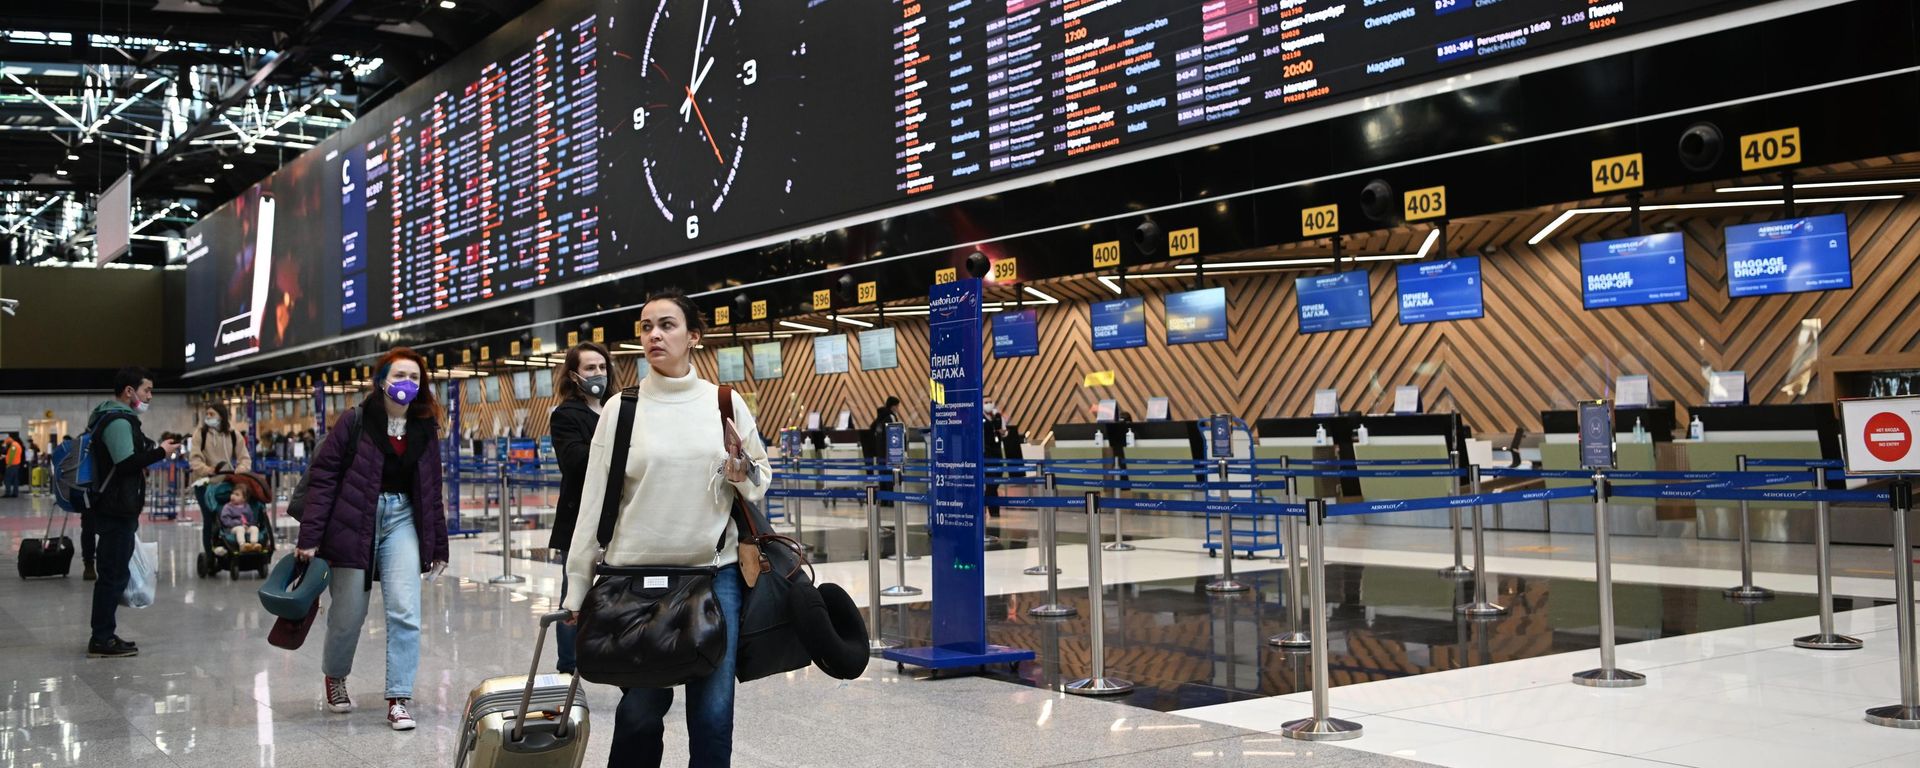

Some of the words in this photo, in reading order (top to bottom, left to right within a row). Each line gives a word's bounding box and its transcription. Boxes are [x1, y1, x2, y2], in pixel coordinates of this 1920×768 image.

[1364, 7, 1416, 29] Cherepovets
[1561, 11, 1586, 26] 21:05
[1589, 16, 1617, 30] SU204
[1065, 28, 1087, 43] 17:00
[743, 59, 757, 85] 3
[1283, 60, 1313, 78] 20:00
[1366, 57, 1405, 74] Magadan
[633, 107, 645, 130] 9
[1744, 135, 1796, 163] 405
[1595, 160, 1640, 185] 404
[1407, 192, 1442, 214] 403
[686, 215, 699, 239] 6
[1304, 210, 1336, 231] 402
[1171, 233, 1195, 251] 401
[1095, 247, 1118, 263] 400
[995, 262, 1015, 277] 399
[1734, 257, 1784, 270] BAGGAGE
[1588, 271, 1631, 283] BAGGAGE
[1734, 265, 1787, 278] DROP-OFF
[1588, 279, 1634, 291] DROP-OFF
[859, 286, 875, 299] 397
[1402, 292, 1429, 301] ПРИЕМ
[815, 294, 829, 306] 396
[932, 297, 960, 307] AEROFLOT
[1403, 298, 1434, 308] БАГАЖА
[716, 310, 728, 322] 394
[753, 304, 765, 316] 395
[1302, 309, 1329, 319] БАГАЖА
[1094, 324, 1118, 332] ECONOMY
[1094, 330, 1118, 338] CHECK-IN
[931, 354, 960, 367] ПРИЕМ
[931, 367, 965, 380] БАГАЖА
[936, 475, 944, 487] 23
[936, 513, 944, 525] 10
